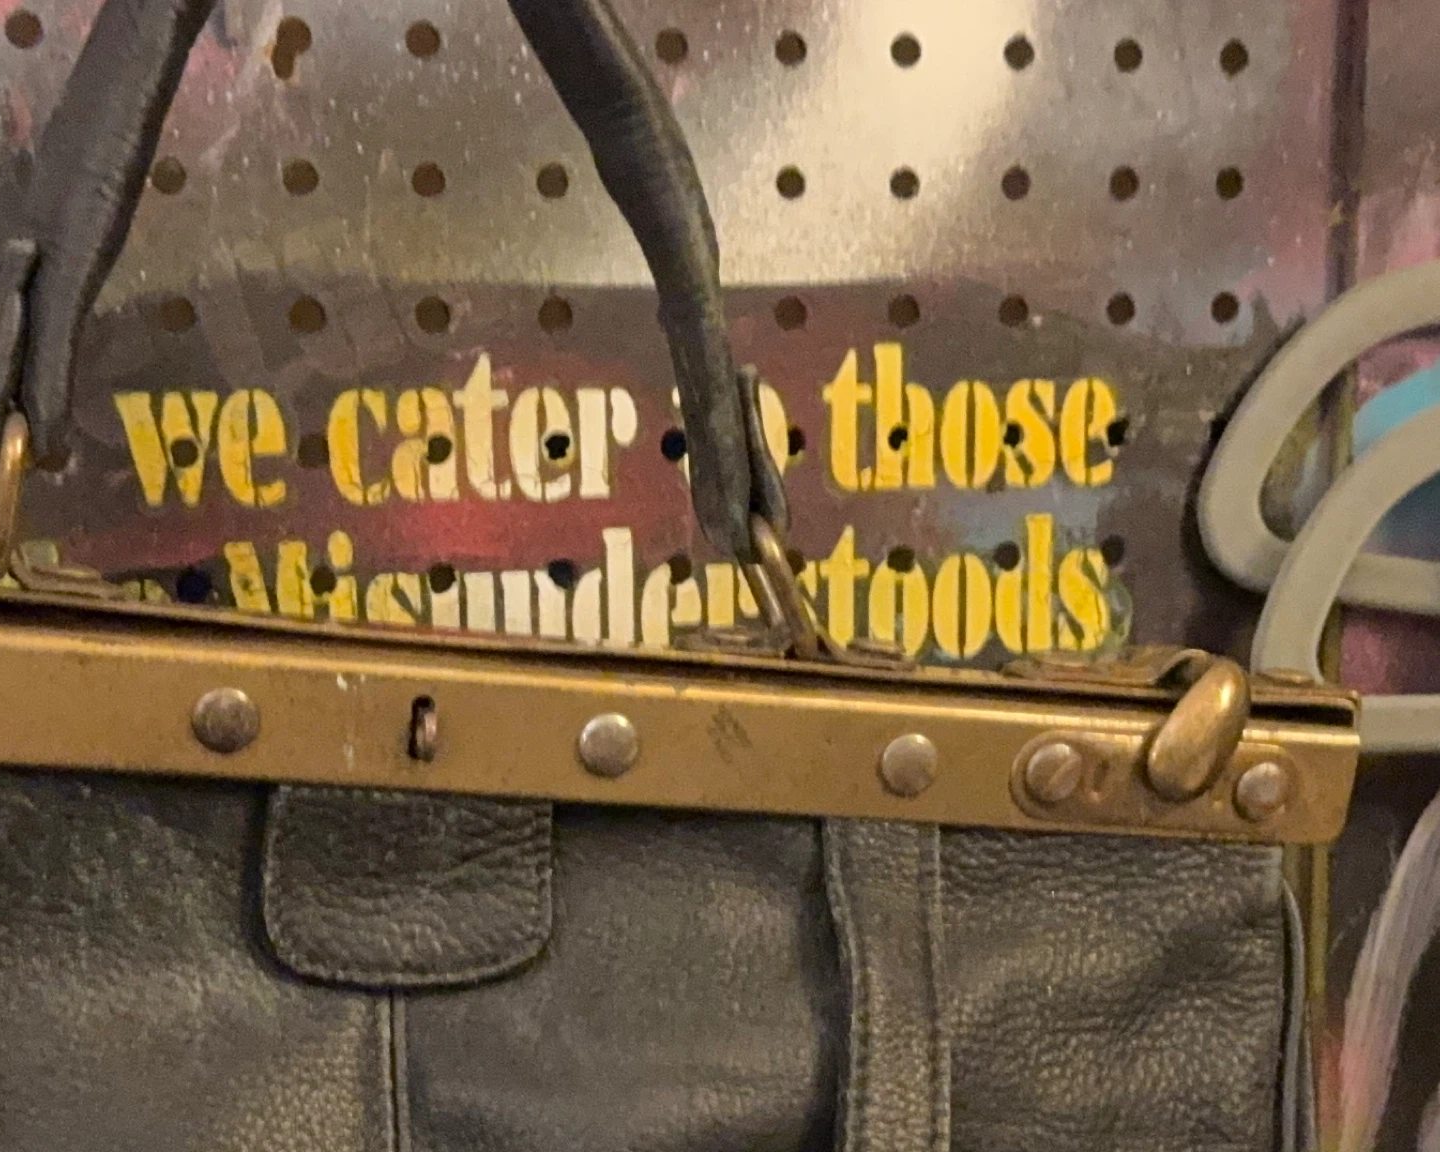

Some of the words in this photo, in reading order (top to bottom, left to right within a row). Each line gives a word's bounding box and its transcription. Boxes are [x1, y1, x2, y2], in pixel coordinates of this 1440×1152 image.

[112, 389, 287, 507] we
[327, 352, 637, 504] cater
[822, 342, 1117, 488] those
